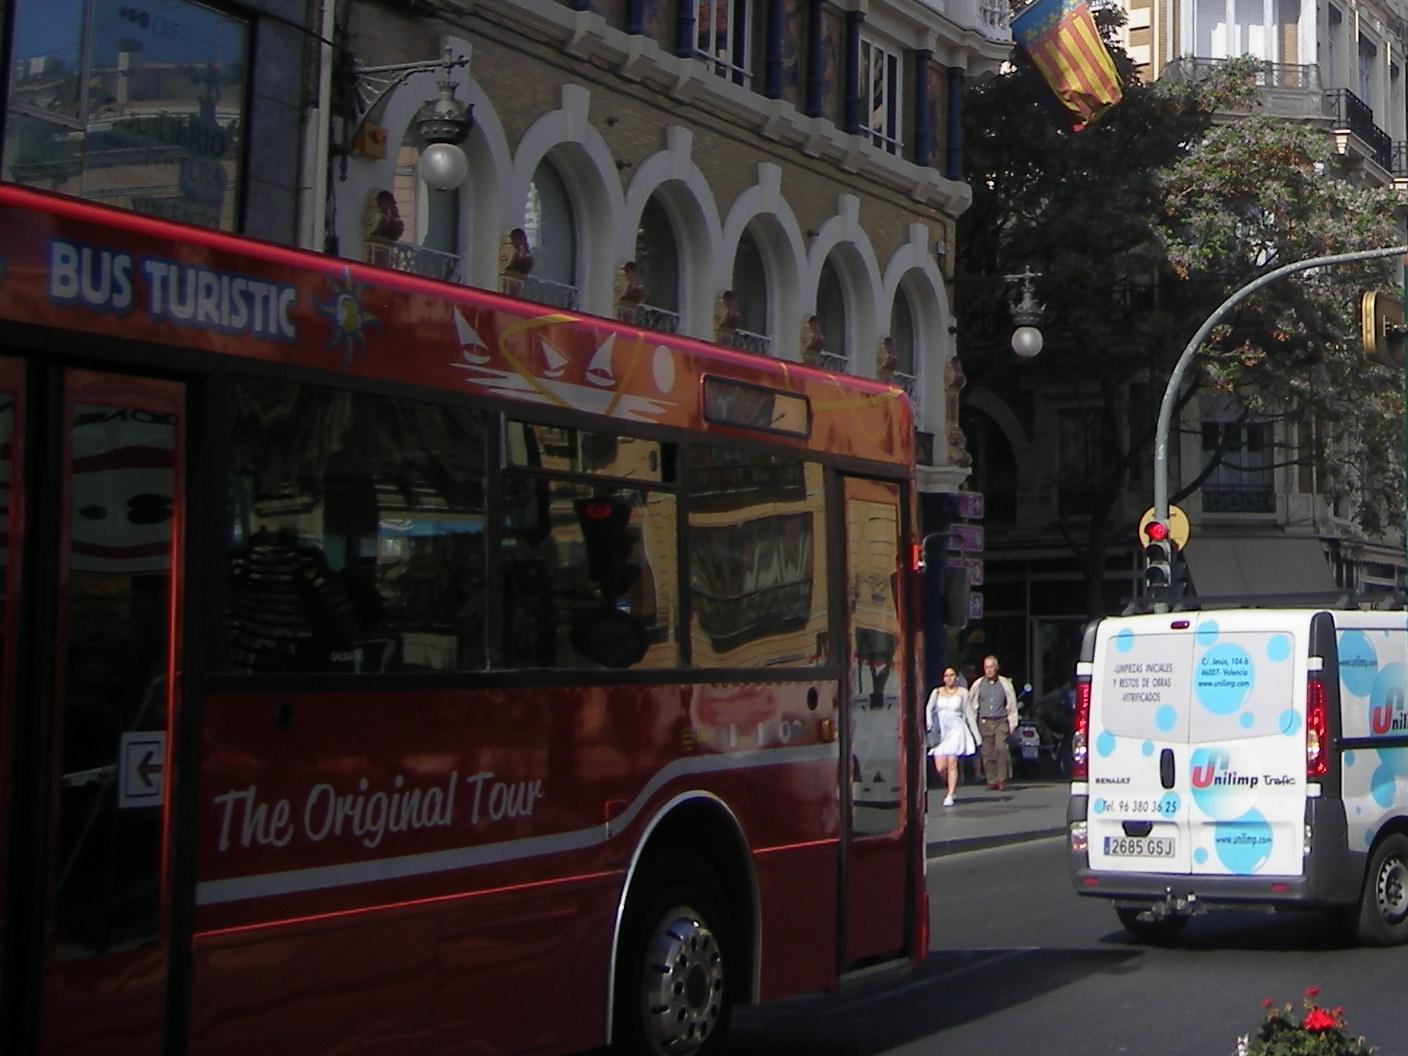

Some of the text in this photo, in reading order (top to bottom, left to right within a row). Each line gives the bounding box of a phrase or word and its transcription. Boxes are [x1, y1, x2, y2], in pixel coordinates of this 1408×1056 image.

[50, 241, 297, 338] BUS TURISTIC
[1119, 678, 1139, 688] RESTOS
[1141, 678, 1150, 688] DE
[1153, 677, 1172, 688] OBRAS
[1095, 777, 1131, 785] RENAULT
[1191, 758, 1259, 789] Unilimp
[213, 770, 544, 852] The Original Tour
[1118, 800, 1129, 812] 96
[1132, 801, 1148, 812] 380
[1151, 801, 1162, 812] 36
[1165, 801, 1177, 813] 25
[1112, 838, 1172, 856] 2685 GSJ
